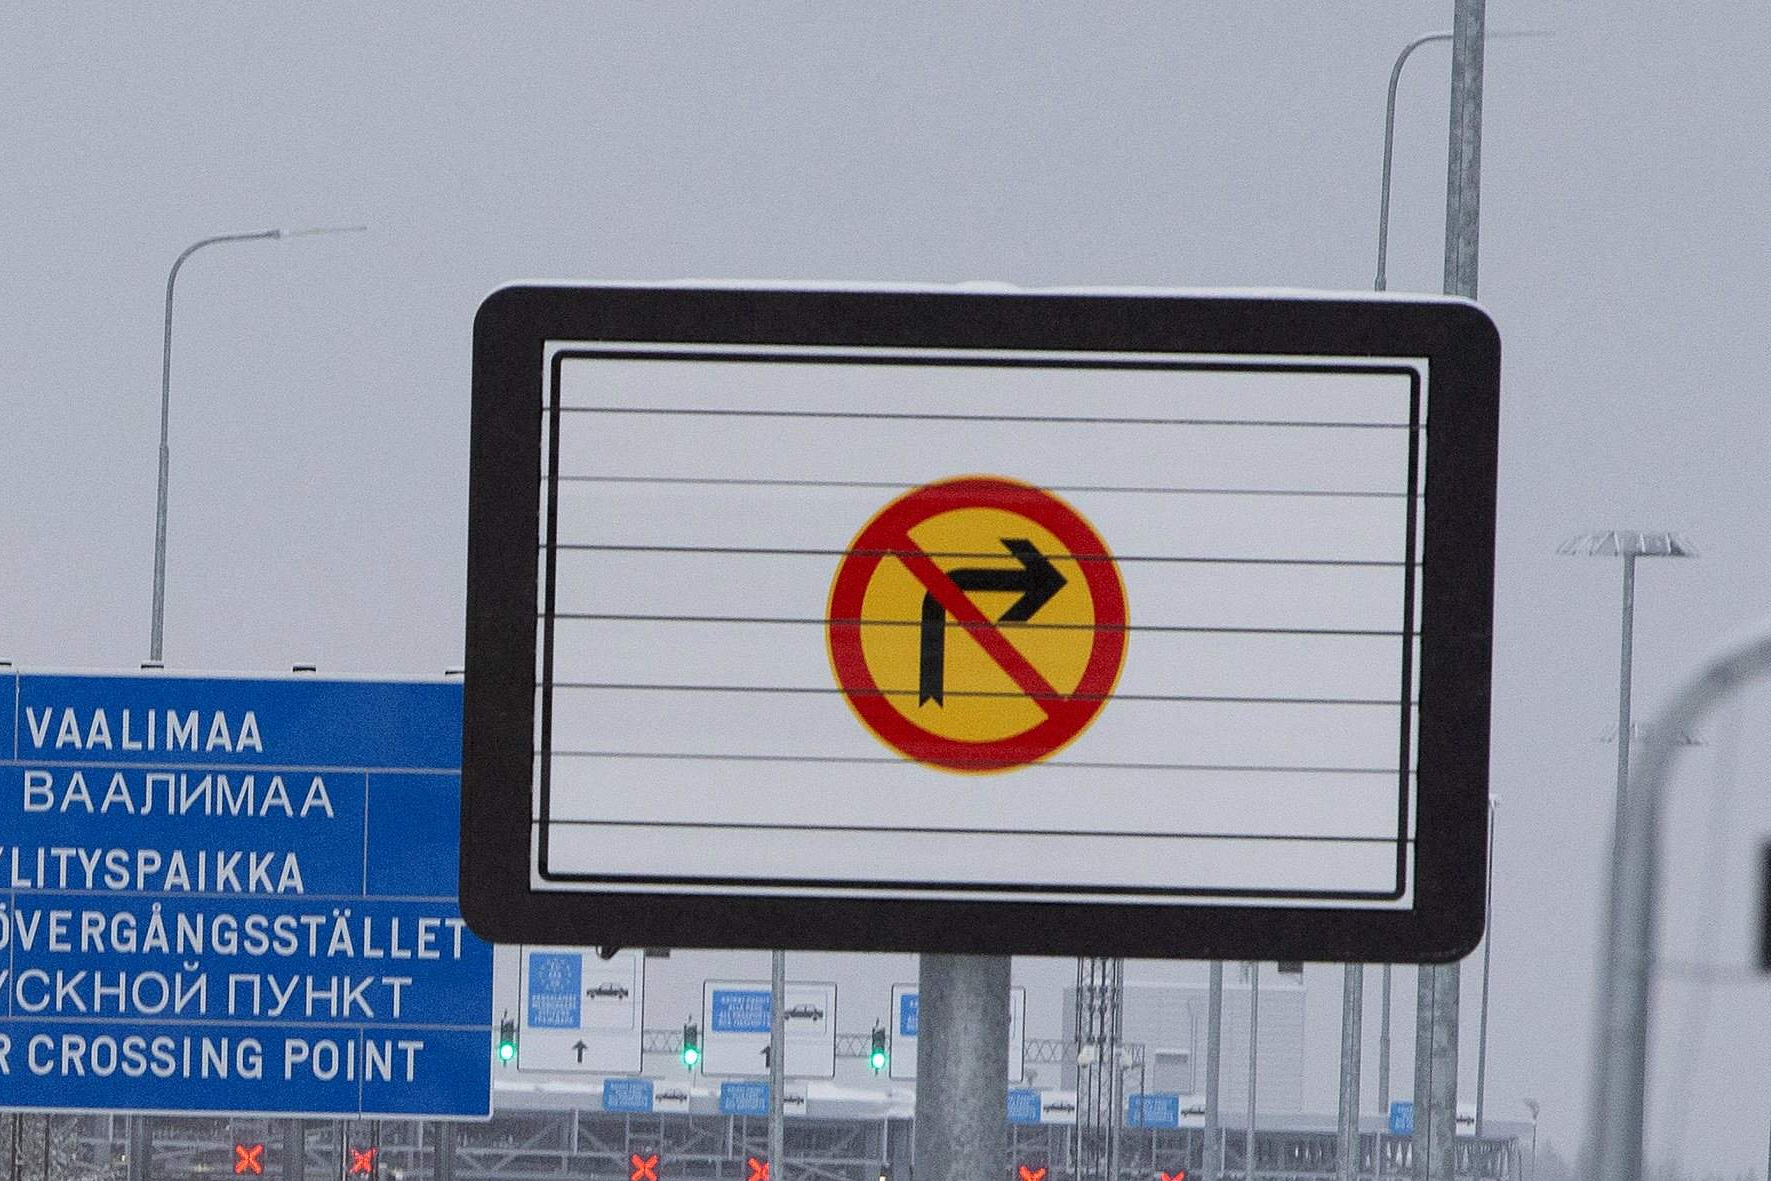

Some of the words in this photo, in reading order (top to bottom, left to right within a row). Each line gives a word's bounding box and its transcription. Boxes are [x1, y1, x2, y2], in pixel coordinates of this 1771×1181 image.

[26, 707, 263, 752] VAALIMAA
[23, 770, 334, 817] ВААЛИМАА
[227, 974, 413, 1019] ПУНКТ
[27, 1034, 263, 1078] CROSSING
[284, 1039, 424, 1081] POINT
